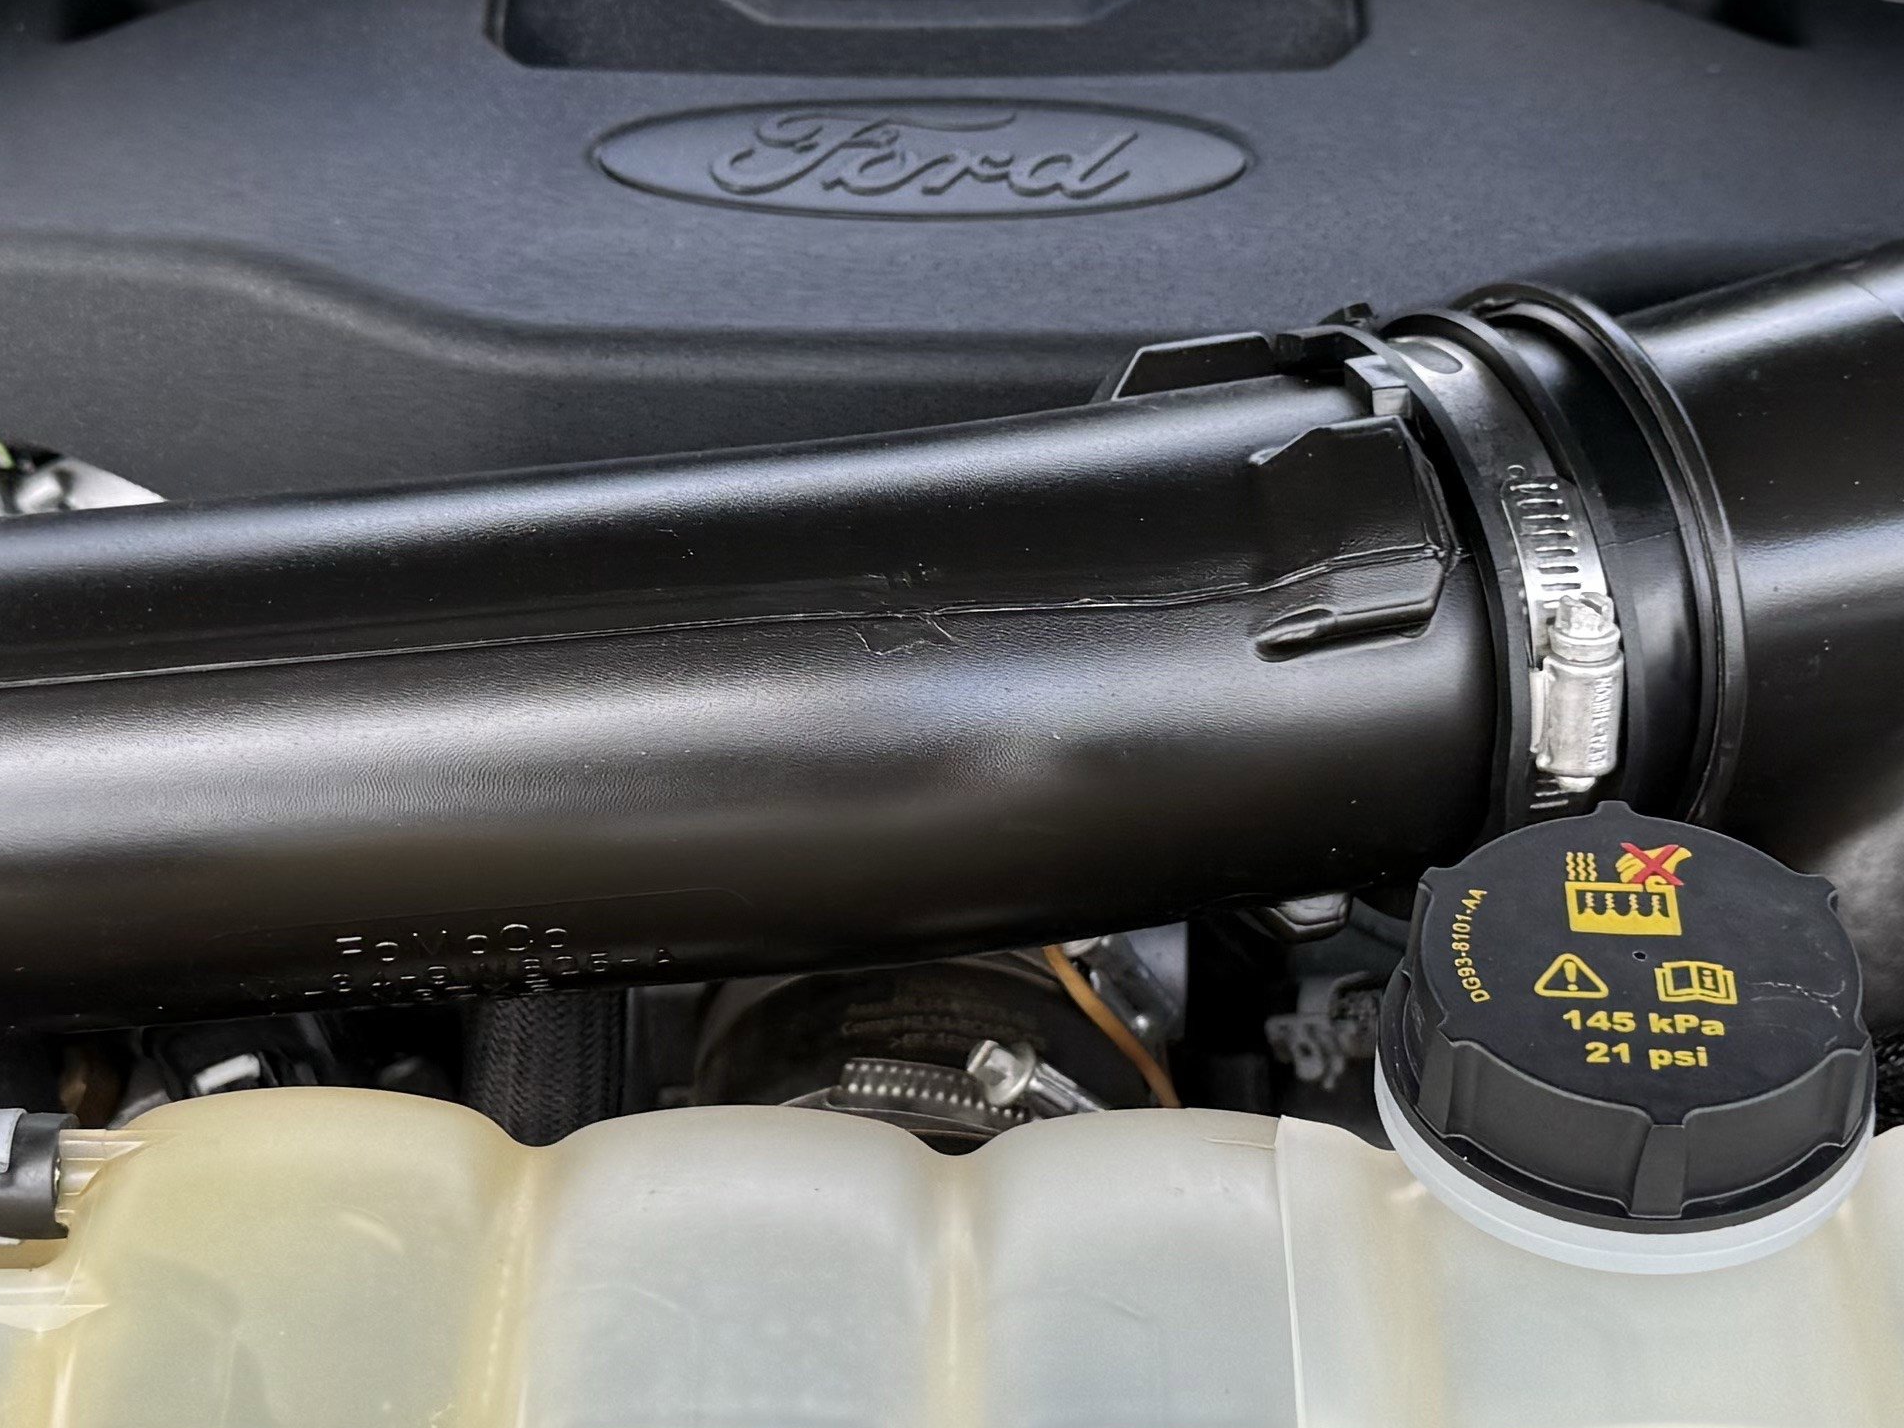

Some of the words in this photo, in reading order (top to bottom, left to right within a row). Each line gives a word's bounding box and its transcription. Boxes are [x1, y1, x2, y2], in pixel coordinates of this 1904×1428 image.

[710, 111, 1139, 198] Ford
[1449, 887, 1490, 1004] DG93-8101-AA
[1562, 1009, 1635, 1033] 145
[1649, 1012, 1726, 1037] kPa
[1585, 1043, 1631, 1065] 21
[1649, 1045, 1708, 1070] psi
